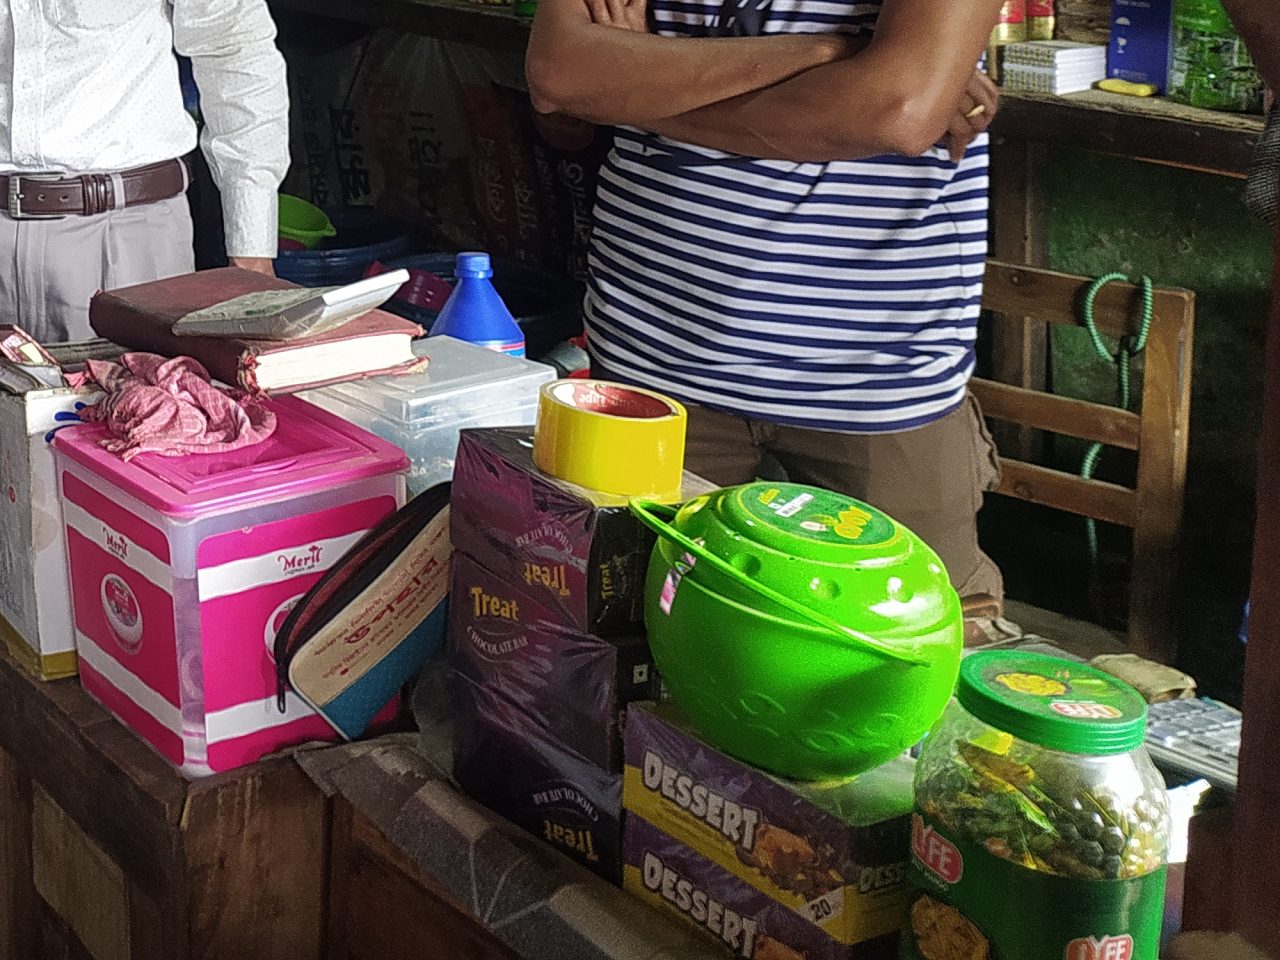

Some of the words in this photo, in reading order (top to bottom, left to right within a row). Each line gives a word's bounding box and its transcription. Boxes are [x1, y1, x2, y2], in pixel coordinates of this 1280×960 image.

[103, 526, 128, 556] Meril
[277, 545, 323, 571] Meril
[523, 561, 571, 596] Treat
[470, 586, 519, 622] Treat
[643, 749, 760, 851] DESSERT
[543, 819, 599, 863] Treat
[643, 851, 760, 959] DESSERT
[810, 897, 833, 922] 20
